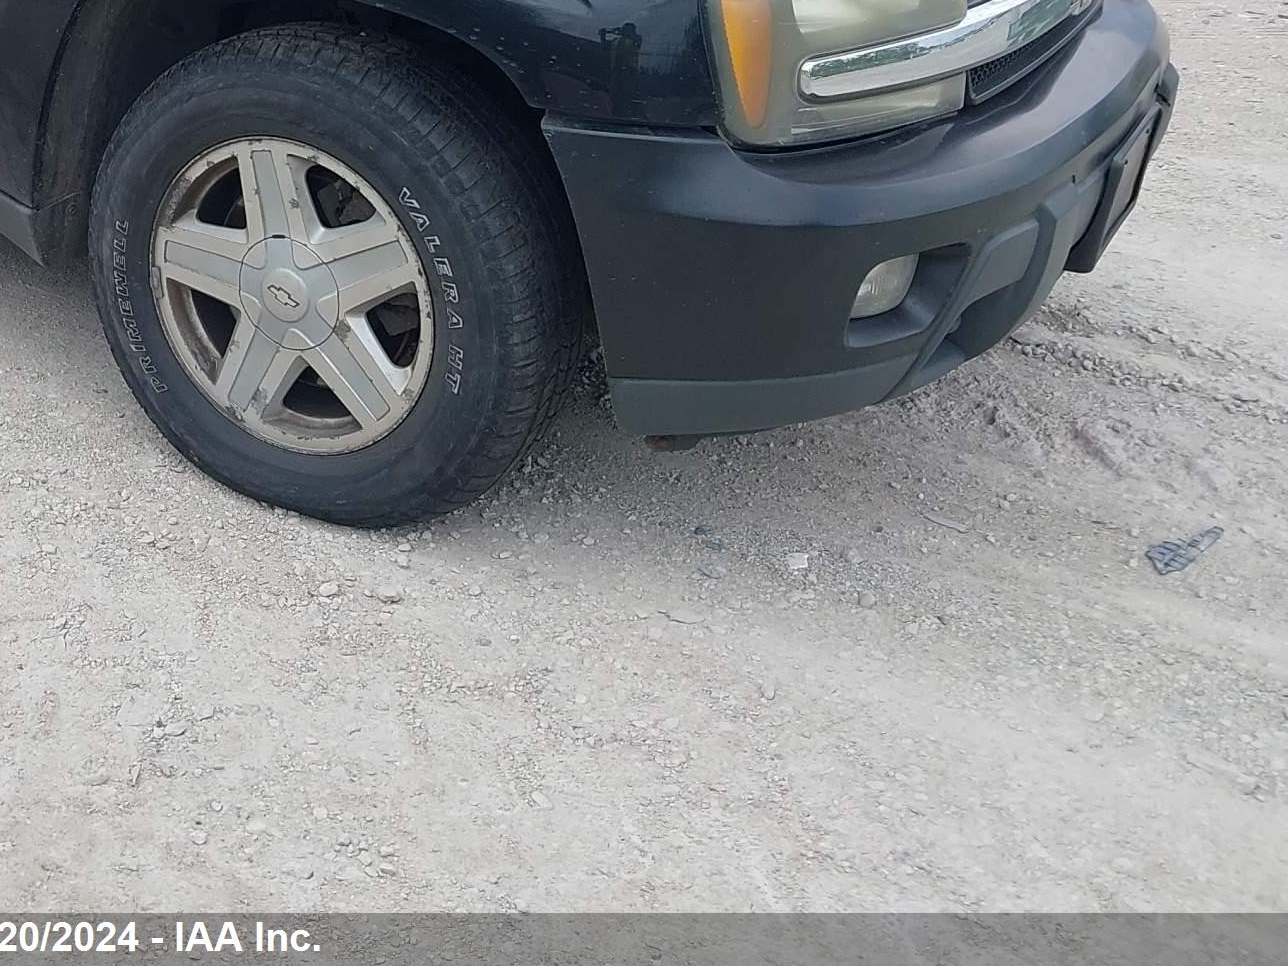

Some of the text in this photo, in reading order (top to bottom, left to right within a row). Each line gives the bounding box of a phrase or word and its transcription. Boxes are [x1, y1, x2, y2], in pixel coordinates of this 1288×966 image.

[113, 218, 167, 393] PRIMEWELL
[396, 186, 467, 394] VALERA HT
